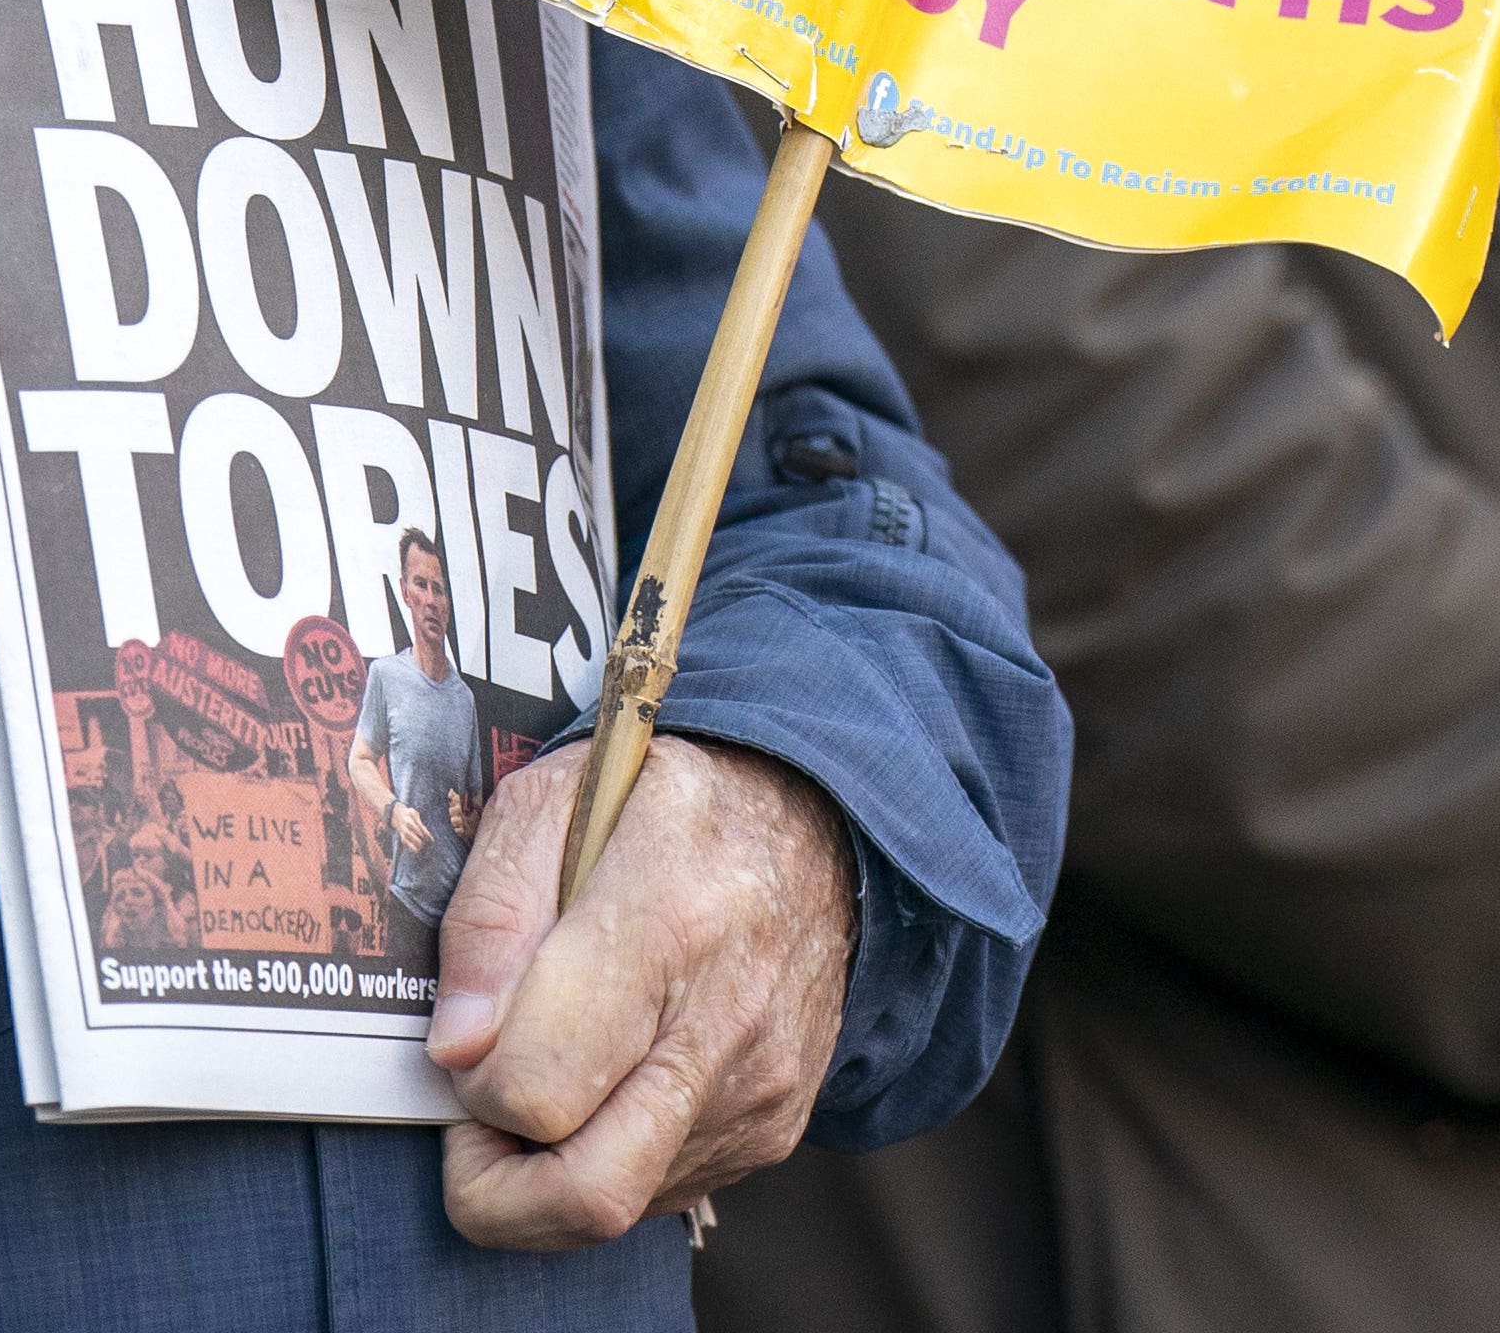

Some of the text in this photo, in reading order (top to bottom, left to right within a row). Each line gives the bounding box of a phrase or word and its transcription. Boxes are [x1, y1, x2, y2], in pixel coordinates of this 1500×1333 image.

[907, 98, 997, 152] tand
[1006, 134, 1046, 170] Up
[1057, 149, 1092, 180] To
[1102, 163, 1221, 197] Racism
[1249, 172, 1396, 206] Scotland
[32, 127, 570, 451] DOWN
[19, 390, 608, 713] TORIES
[300, 639, 341, 671] NO
[301, 669, 362, 704] CUTS
[192, 814, 302, 846] WE LIVE
[204, 859, 272, 889] IN A
[100, 958, 438, 1002] Support the 500,000 workers
